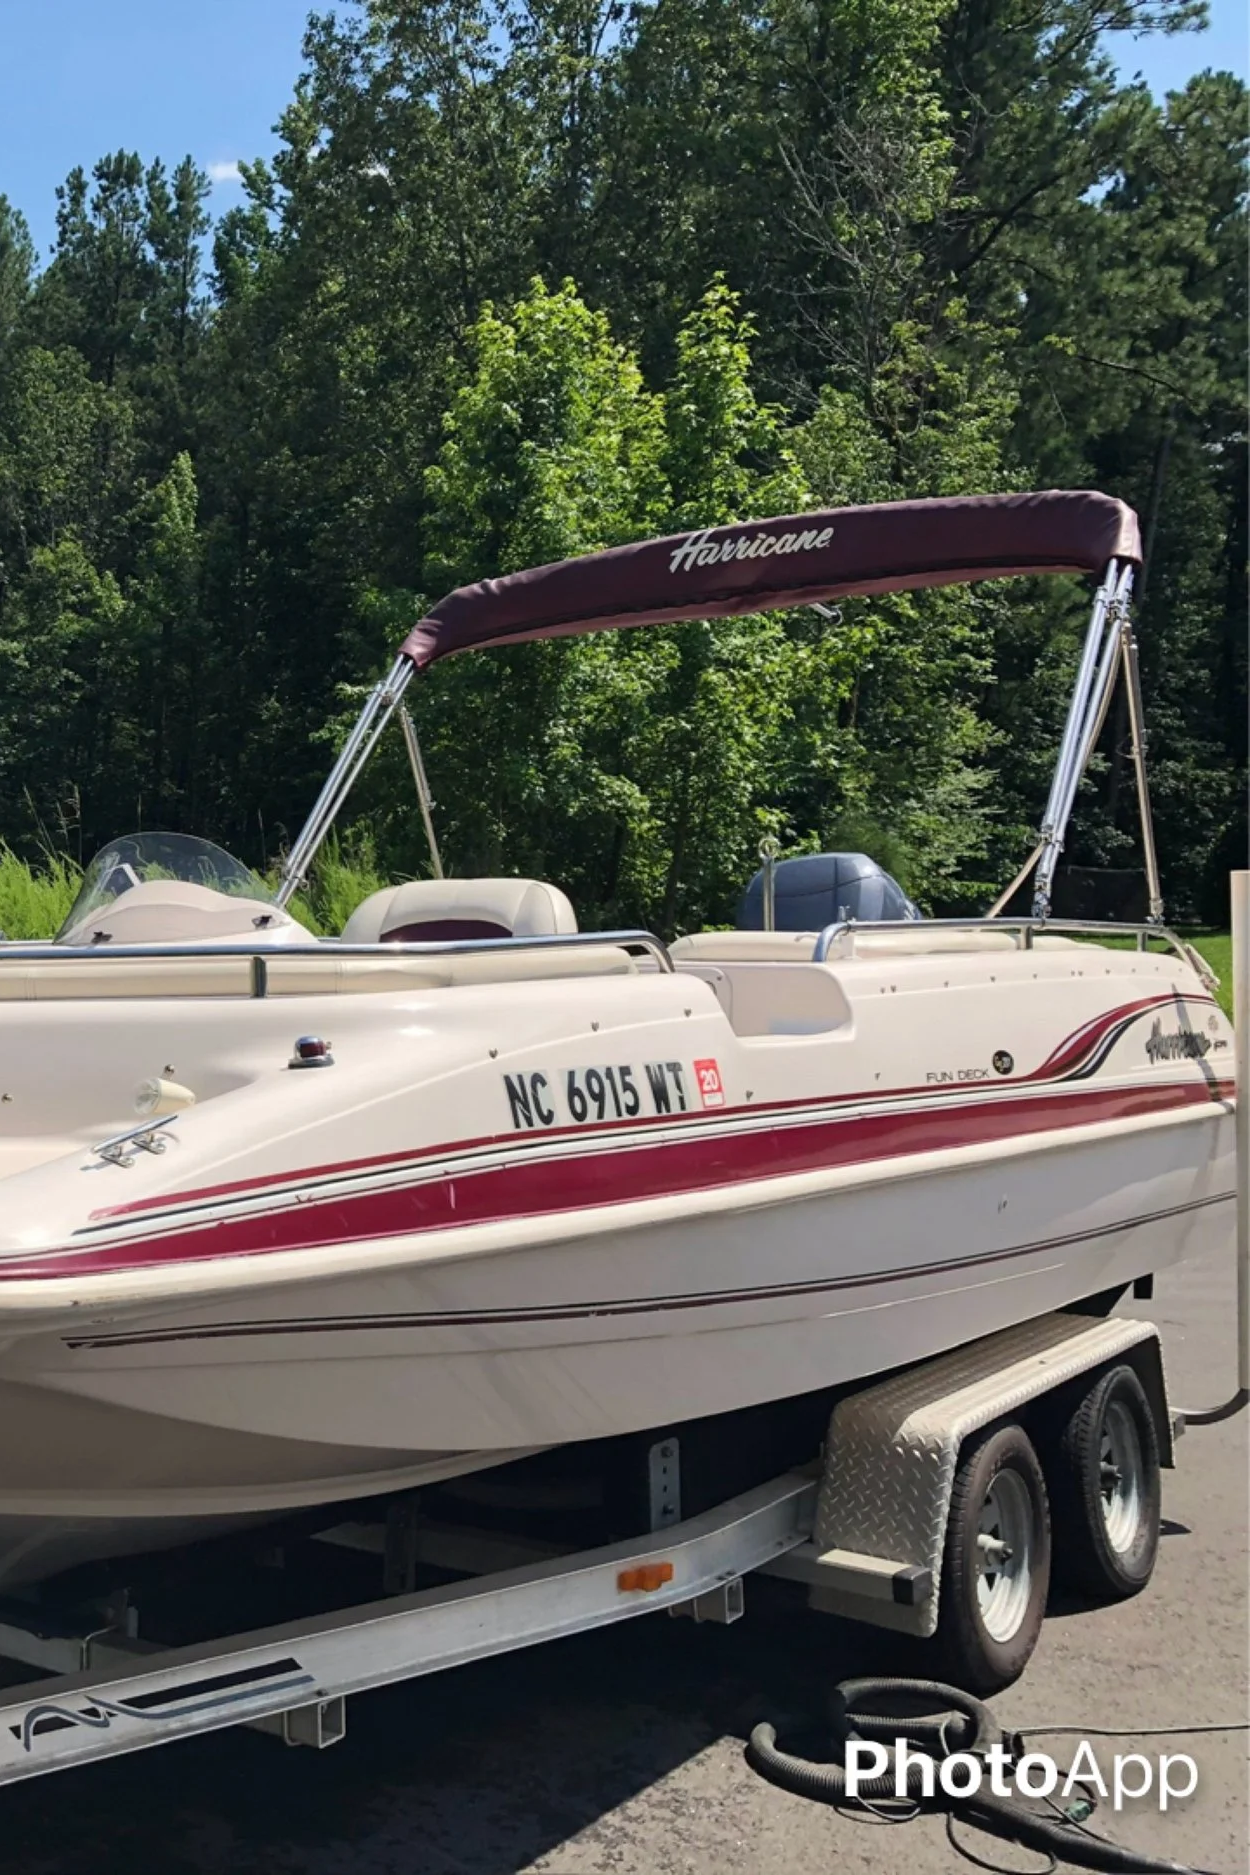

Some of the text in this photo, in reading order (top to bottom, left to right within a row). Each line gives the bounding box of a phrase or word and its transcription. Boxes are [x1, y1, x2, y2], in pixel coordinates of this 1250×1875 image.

[699, 1069, 719, 1091] 20
[926, 1068, 990, 1083] FUN DECK
[502, 1061, 687, 1129] NC 6915 WT
